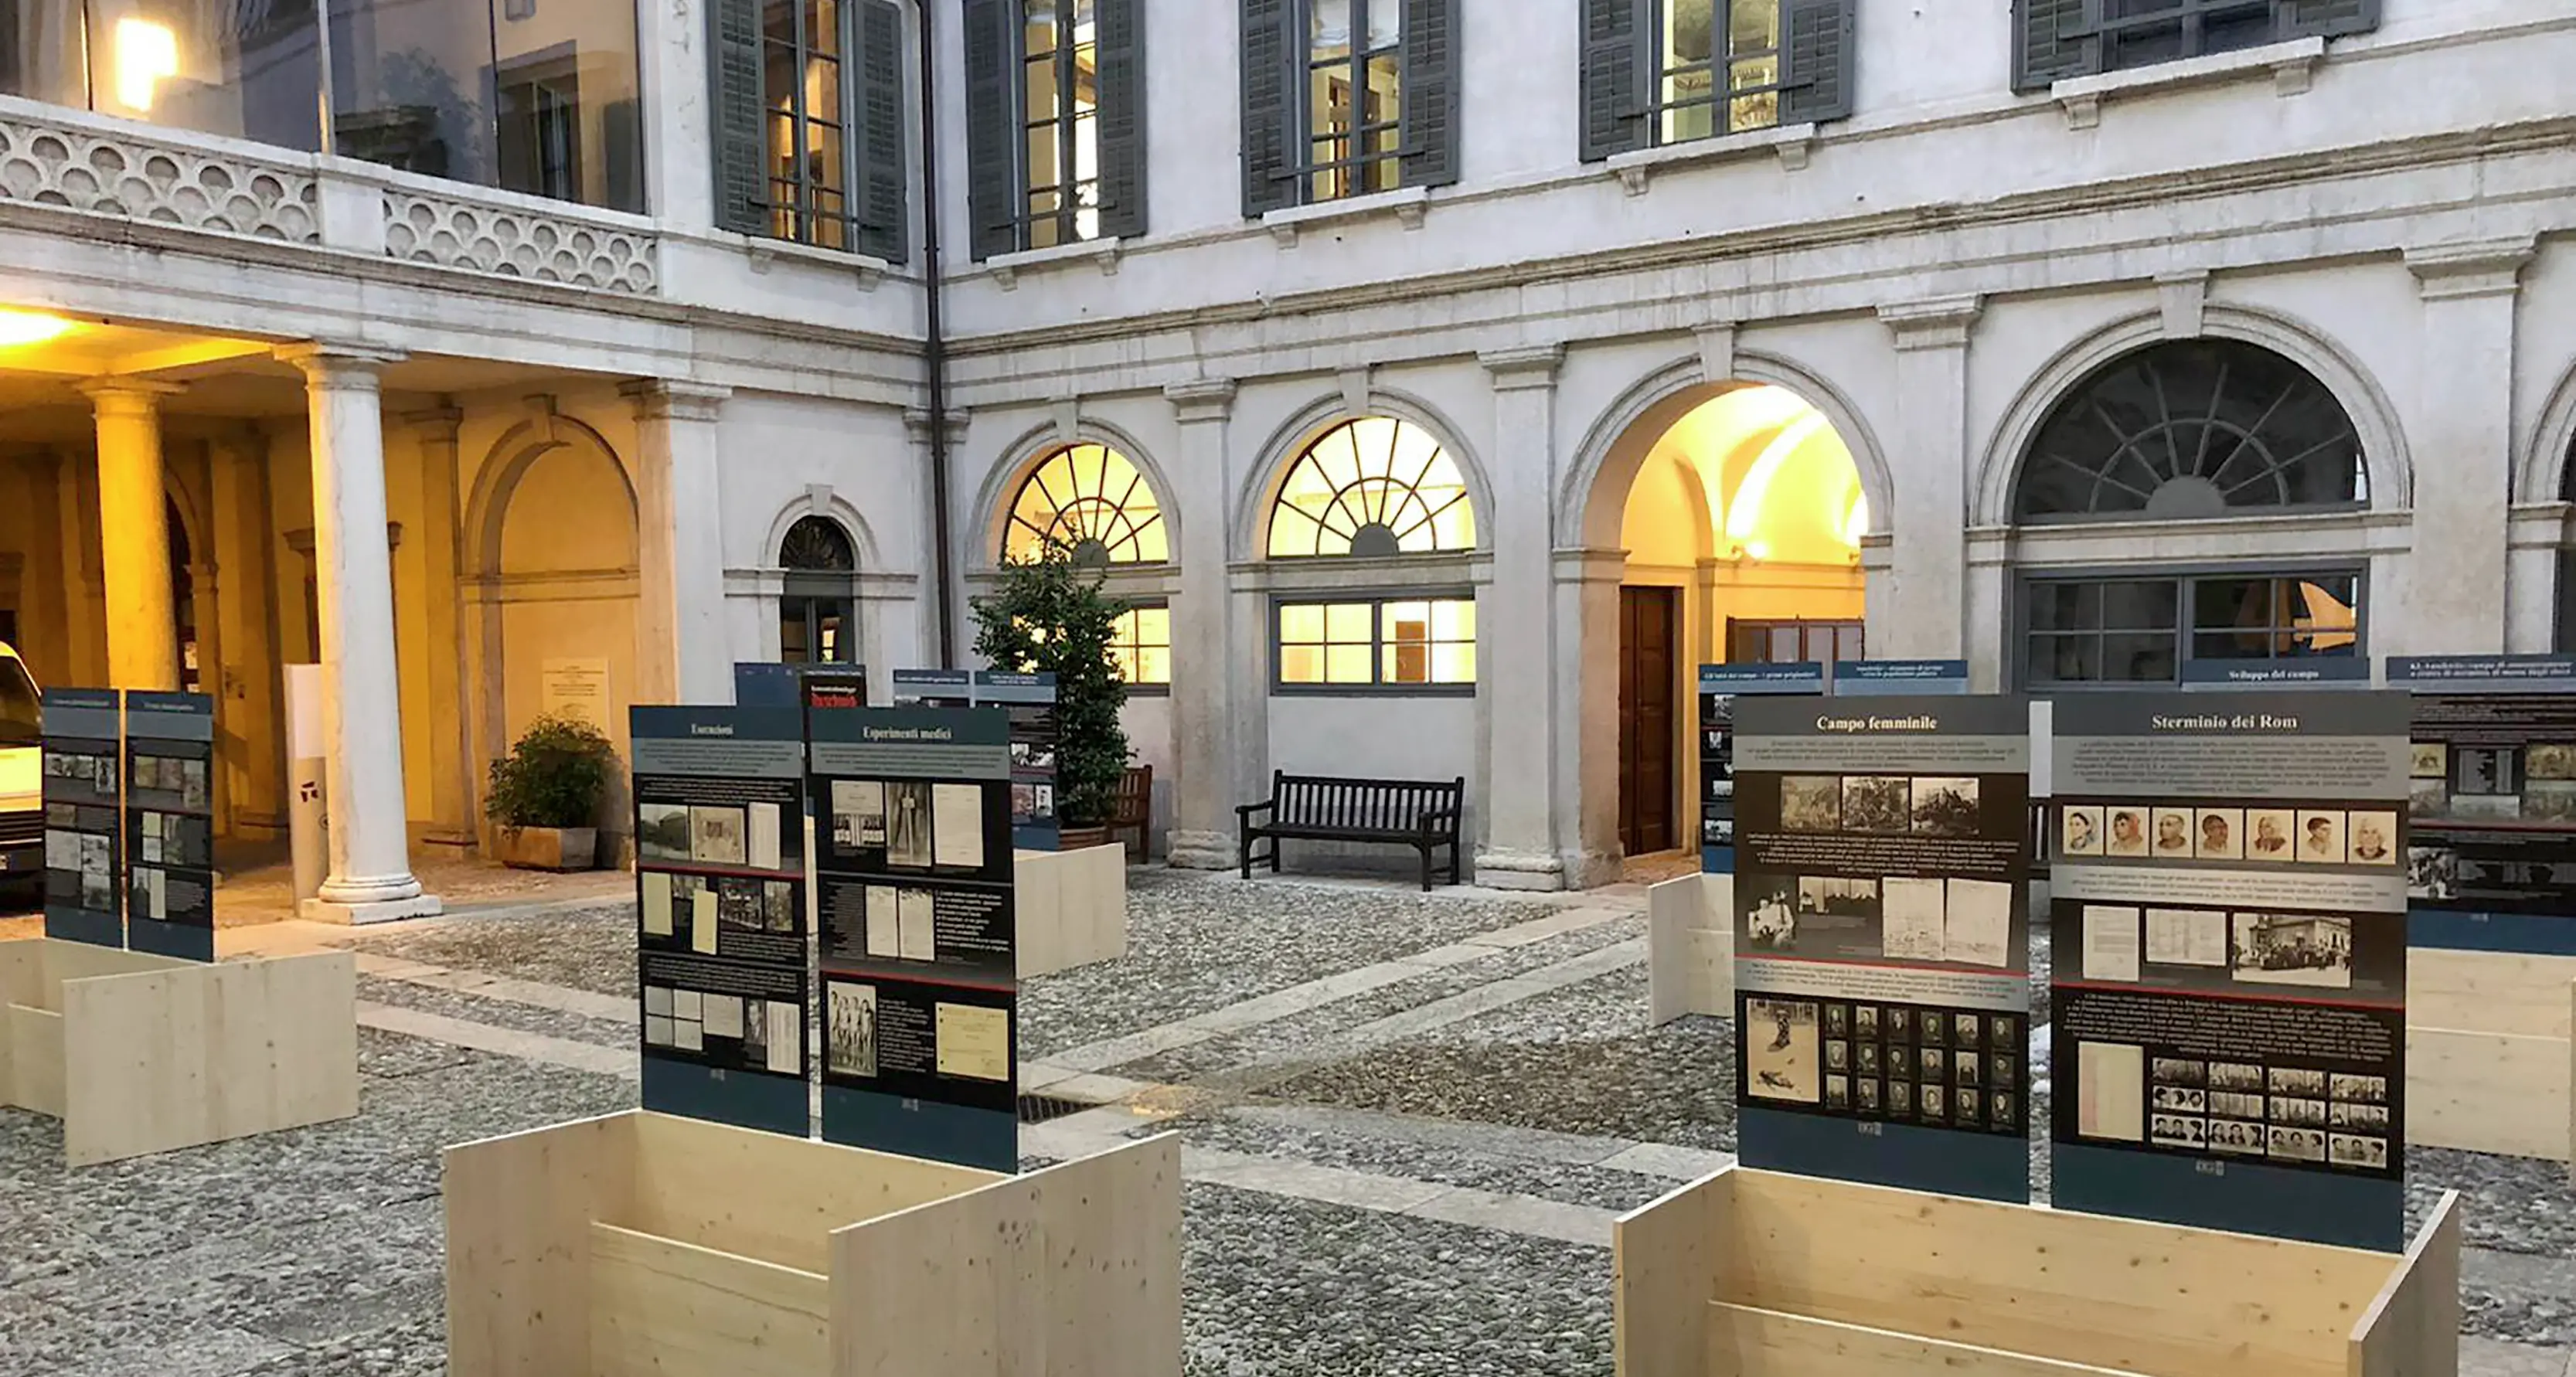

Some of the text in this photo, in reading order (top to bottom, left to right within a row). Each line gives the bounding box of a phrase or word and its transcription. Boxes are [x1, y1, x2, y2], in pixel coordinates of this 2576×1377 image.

[1816, 715, 1938, 733] Campo femminile
[2152, 714, 2298, 729] Sterminio dei Rom
[863, 726, 918, 742] Esperimenti
